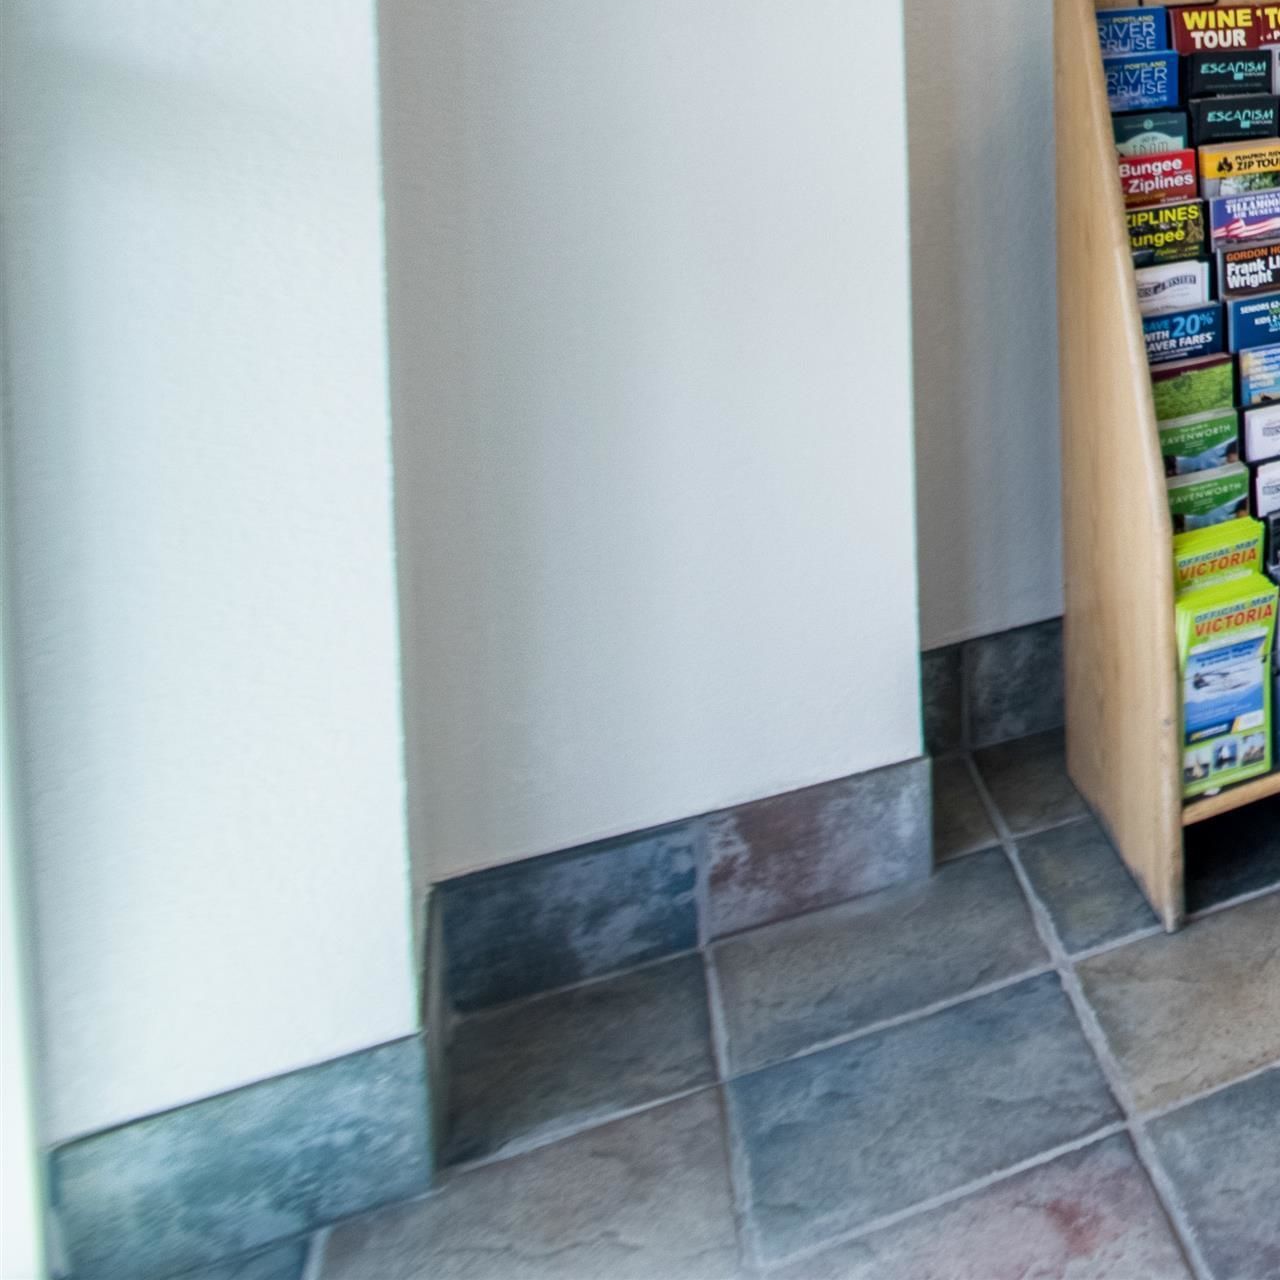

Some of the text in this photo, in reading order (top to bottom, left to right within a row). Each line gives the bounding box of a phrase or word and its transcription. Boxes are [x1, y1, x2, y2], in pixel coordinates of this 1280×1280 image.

[1182, 8, 1252, 30] WINE
[1098, 22, 1156, 39] RIVER
[1191, 30, 1246, 49] TOUR
[1106, 68, 1167, 85] RIVER
[1108, 81, 1167, 97] CRUISE
[1119, 158, 1182, 178] Bungee
[1237, 161, 1254, 170] ZIP
[1128, 173, 1194, 194] Ziplines
[1126, 205, 1199, 227] ZIPLINES
[1226, 248, 1268, 262] GORDON
[1227, 260, 1266, 277] Frank
[1227, 271, 1273, 289] Wright
[1179, 538, 1259, 568] OFFICIAL MAP
[1179, 548, 1256, 582] VICTORIA
[1195, 594, 1275, 623] OFFICIAL MAP
[1195, 603, 1272, 637] VICTORIA
